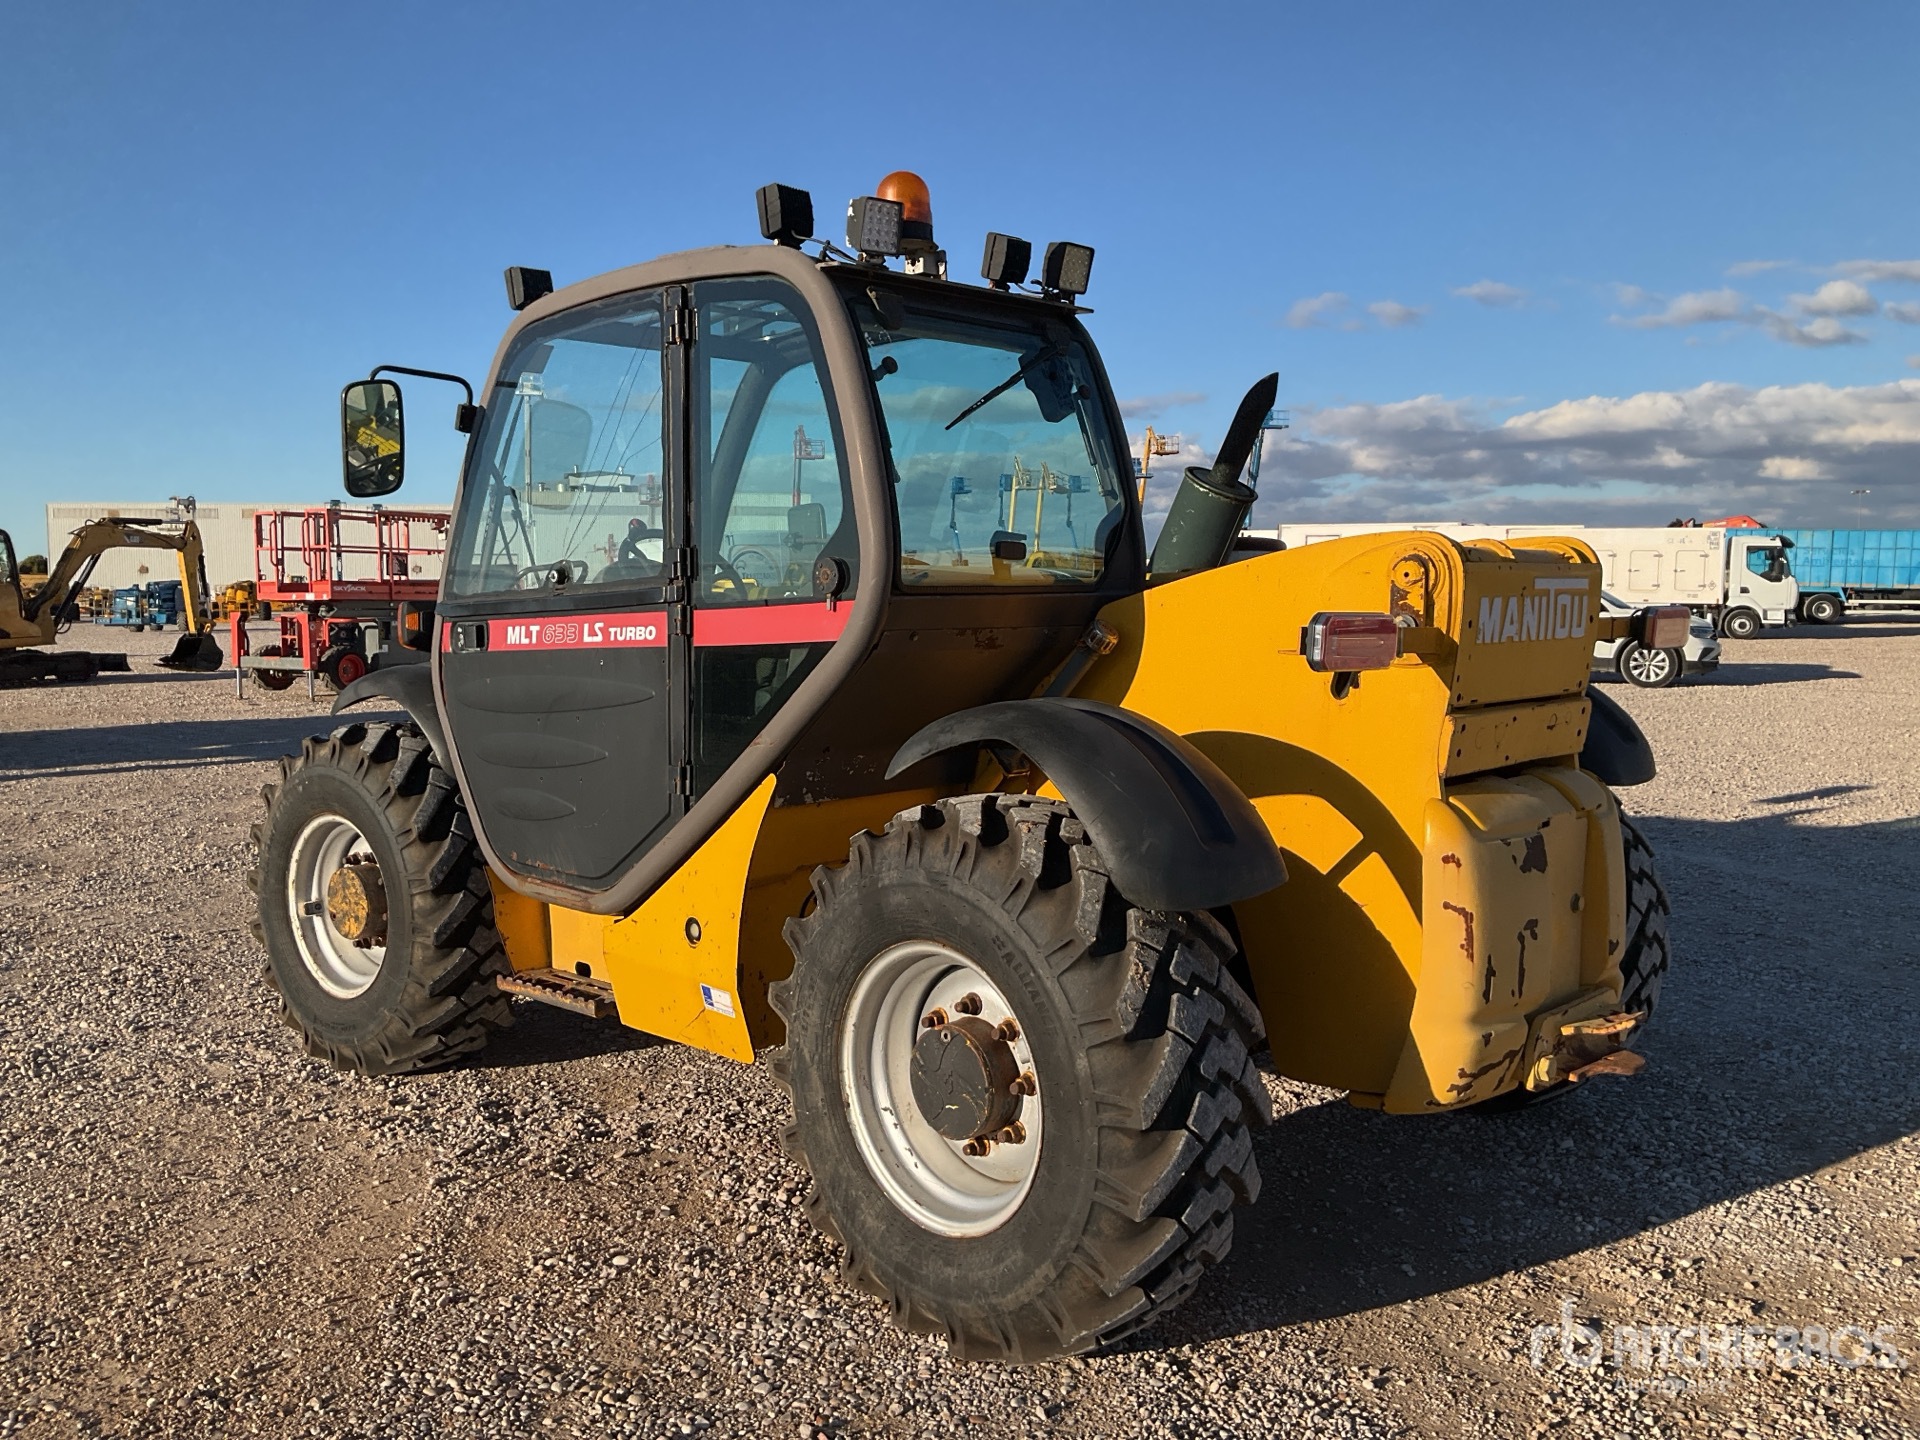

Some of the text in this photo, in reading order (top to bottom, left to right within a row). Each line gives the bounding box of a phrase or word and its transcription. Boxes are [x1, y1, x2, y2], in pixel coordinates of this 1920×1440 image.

[333, 584, 366, 592] SKYJACK
[1476, 578, 1589, 644] MANITOU
[507, 622, 656, 644] MLT 633 LS TURBO
